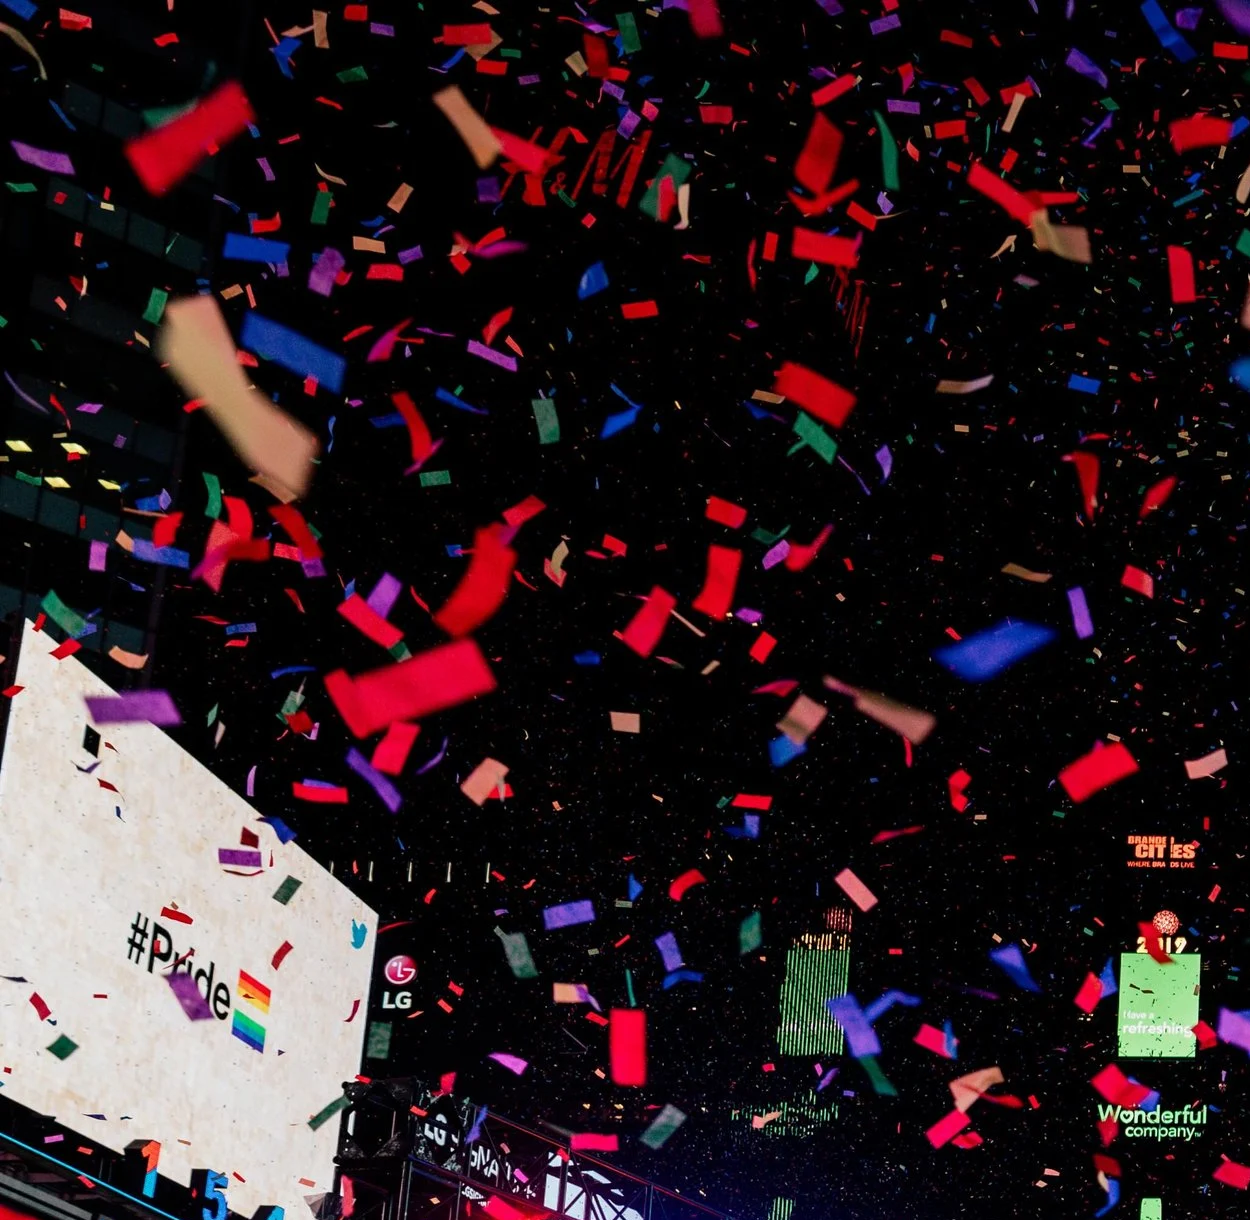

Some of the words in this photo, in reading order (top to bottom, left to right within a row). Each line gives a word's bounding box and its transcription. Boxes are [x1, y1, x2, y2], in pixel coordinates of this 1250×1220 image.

[1136, 937, 1187, 955] 219
[382, 991, 412, 1009] LG
[1123, 1010, 1147, 1019] Have
[1122, 1021, 1193, 1038] refreshing
[1097, 1104, 1208, 1124] Wonderful
